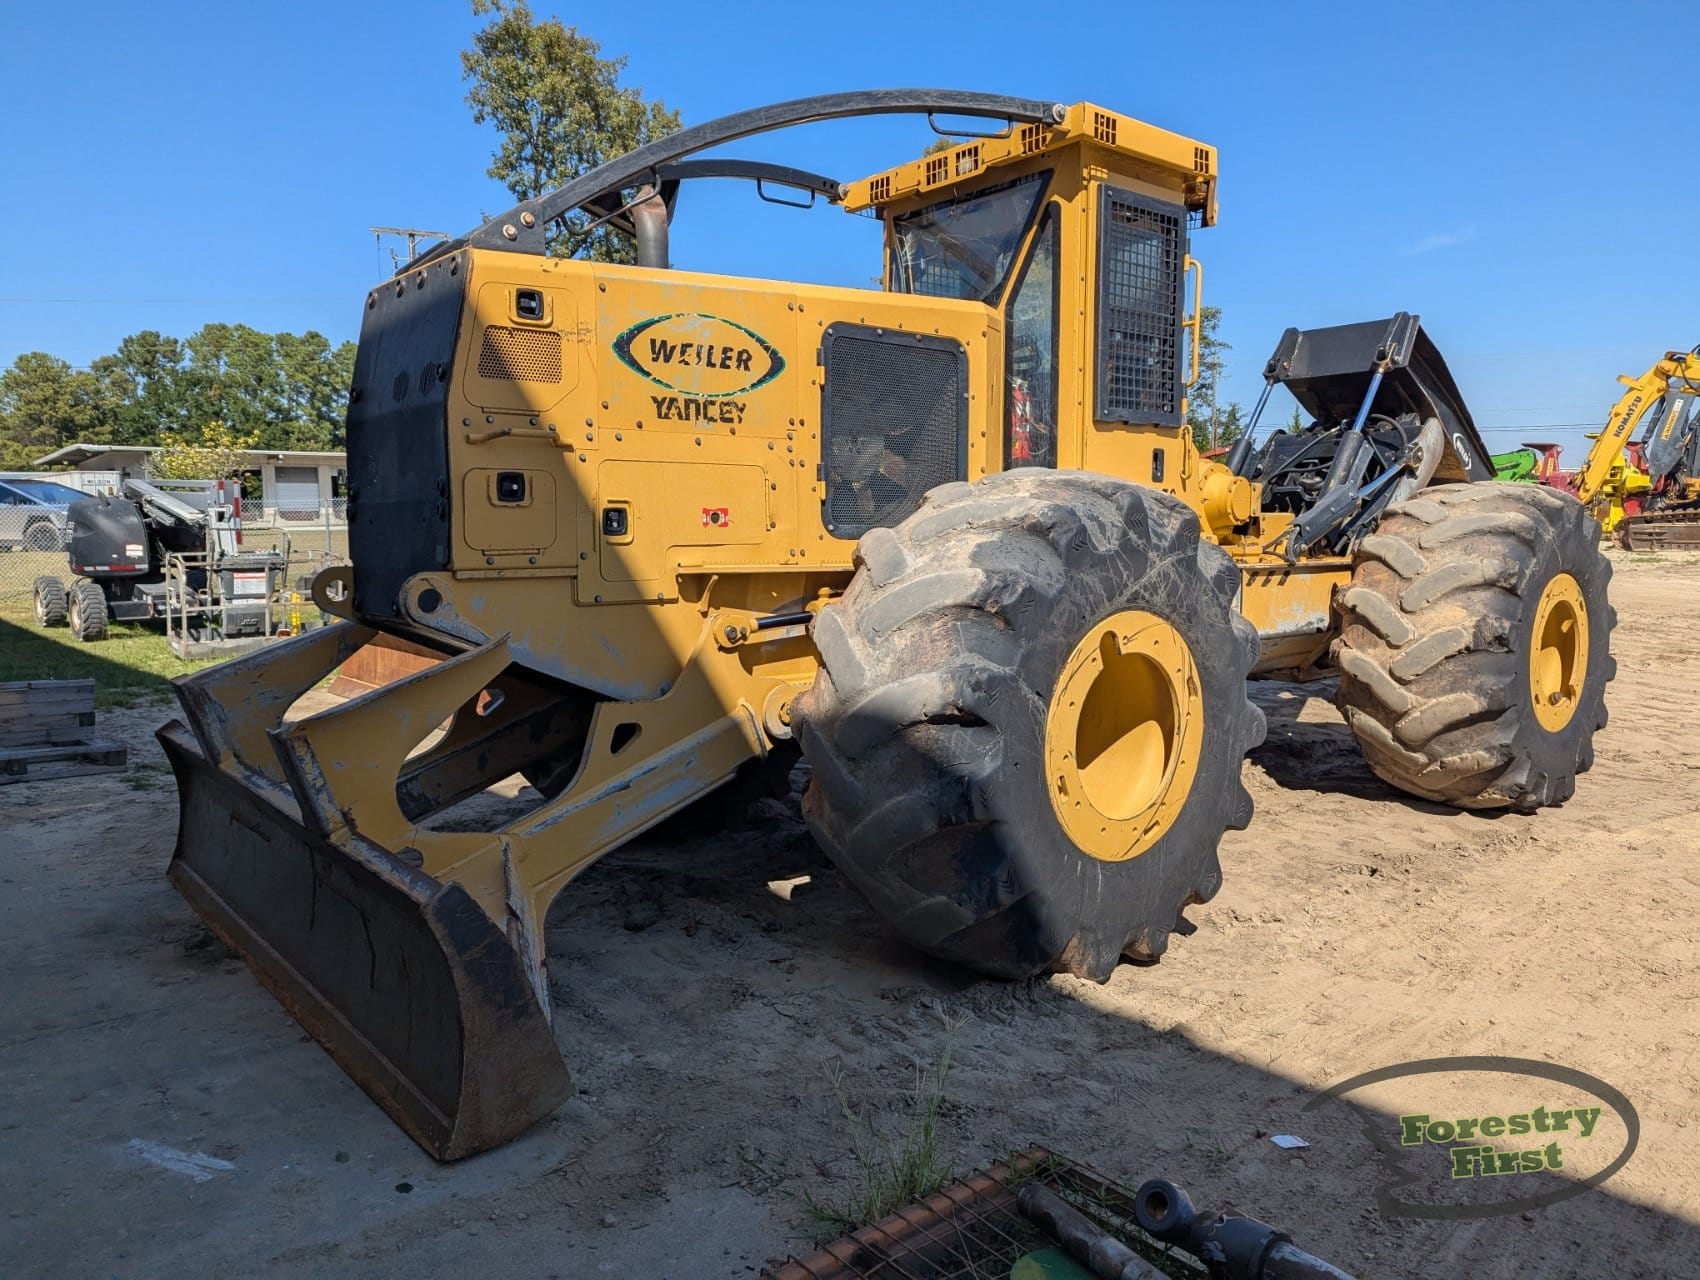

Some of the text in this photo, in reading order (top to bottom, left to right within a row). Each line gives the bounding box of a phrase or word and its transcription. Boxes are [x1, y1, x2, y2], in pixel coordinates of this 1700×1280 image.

[650, 338, 753, 372] WEILER
[650, 395, 747, 424] YANCEY
[1613, 395, 1642, 438] KOMATSU
